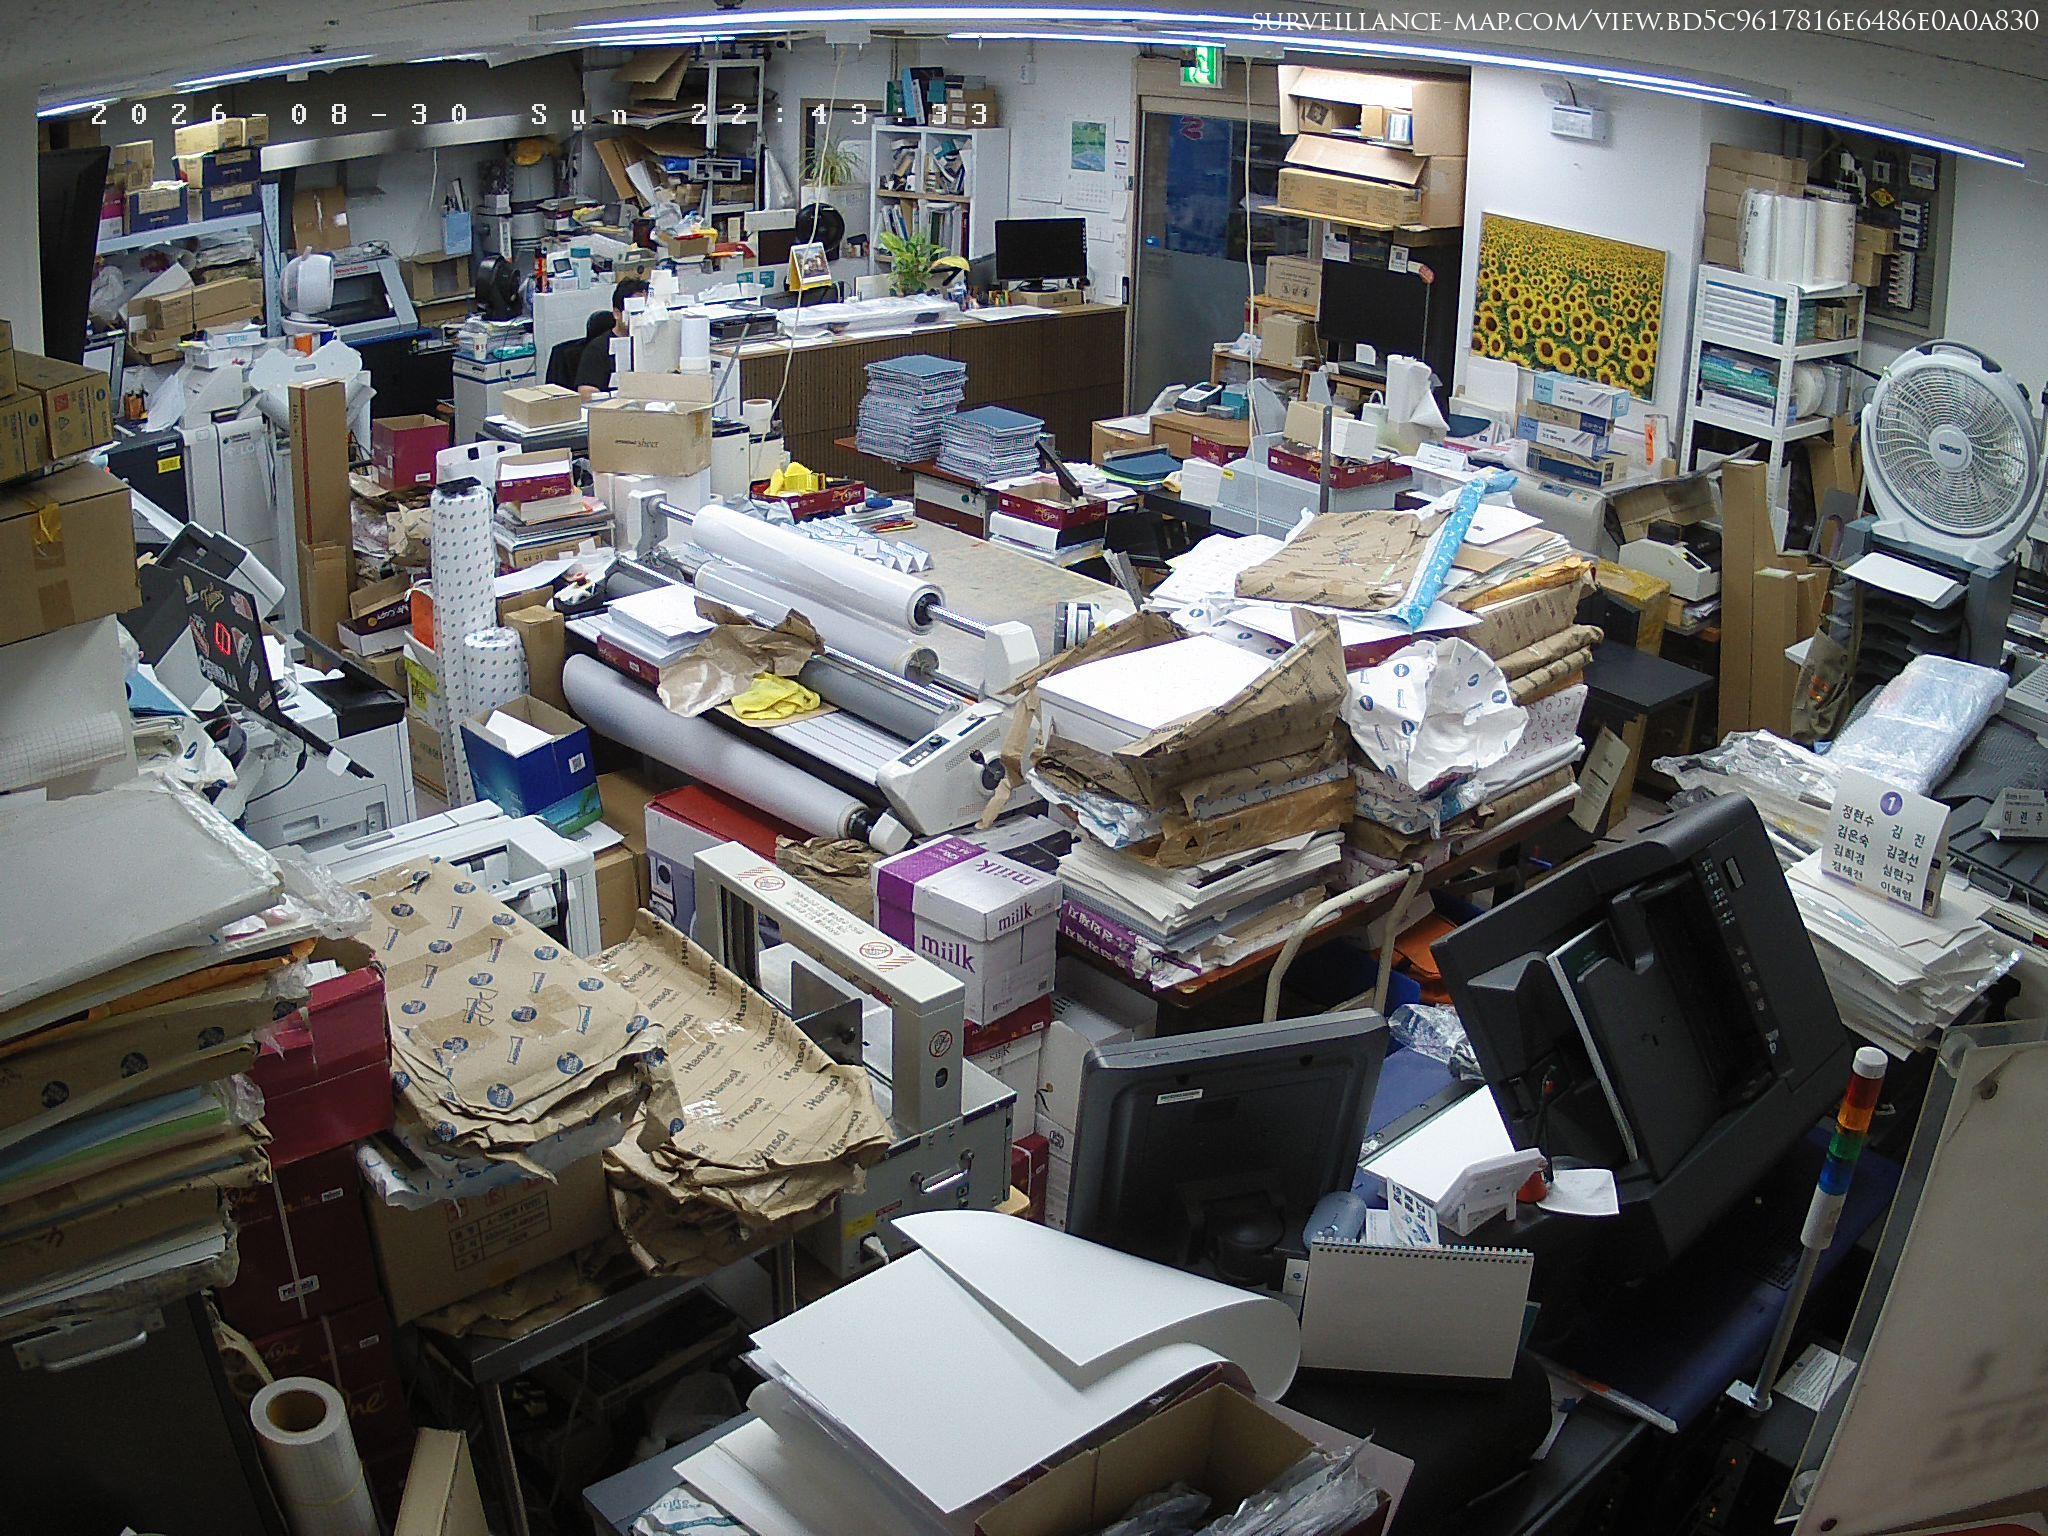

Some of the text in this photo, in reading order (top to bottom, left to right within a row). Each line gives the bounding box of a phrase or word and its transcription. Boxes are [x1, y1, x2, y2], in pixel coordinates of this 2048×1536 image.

[998, 902, 1033, 932] miilk
[921, 934, 976, 974] miilk
[648, 986, 674, 1011] ansol
[665, 1012, 695, 1040] ansol
[678, 1040, 718, 1075] Hansol
[701, 1068, 742, 1102] Hansol
[803, 1074, 841, 1111] Hansol
